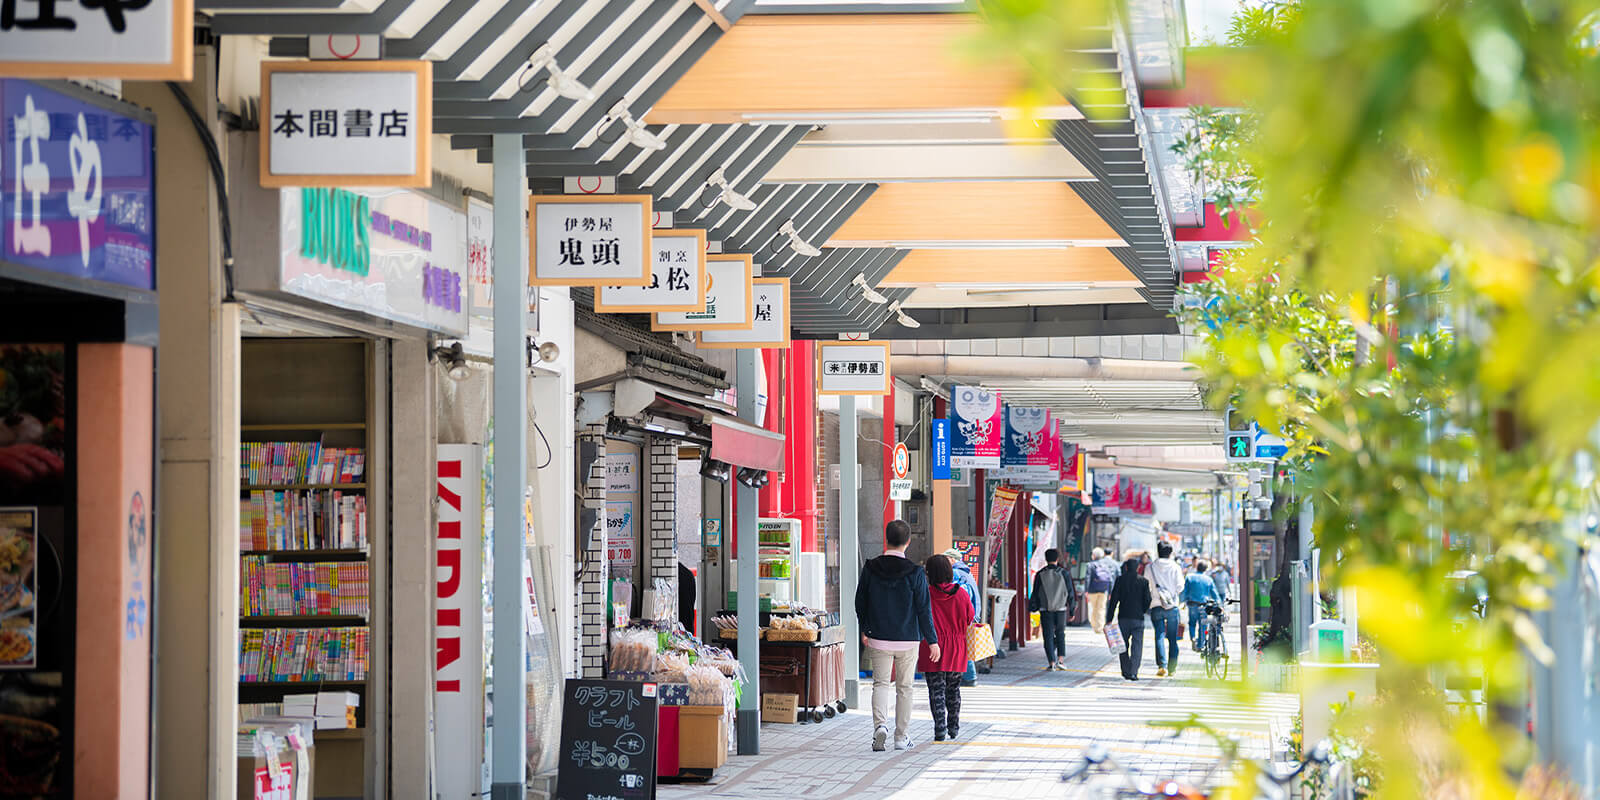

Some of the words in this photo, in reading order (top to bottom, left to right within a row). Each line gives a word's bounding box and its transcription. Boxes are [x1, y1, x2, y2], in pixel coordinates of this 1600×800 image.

[274, 108, 409, 139] 本間書店
[300, 187, 370, 277] BOOKS
[564, 217, 614, 232] 伊勢屋
[558, 237, 620, 266] 鬼頭
[658, 250, 687, 263] 割烹
[574, 686, 641, 711] クラフト
[588, 709, 636, 730] ビール
[571, 740, 630, 770] ¥500
